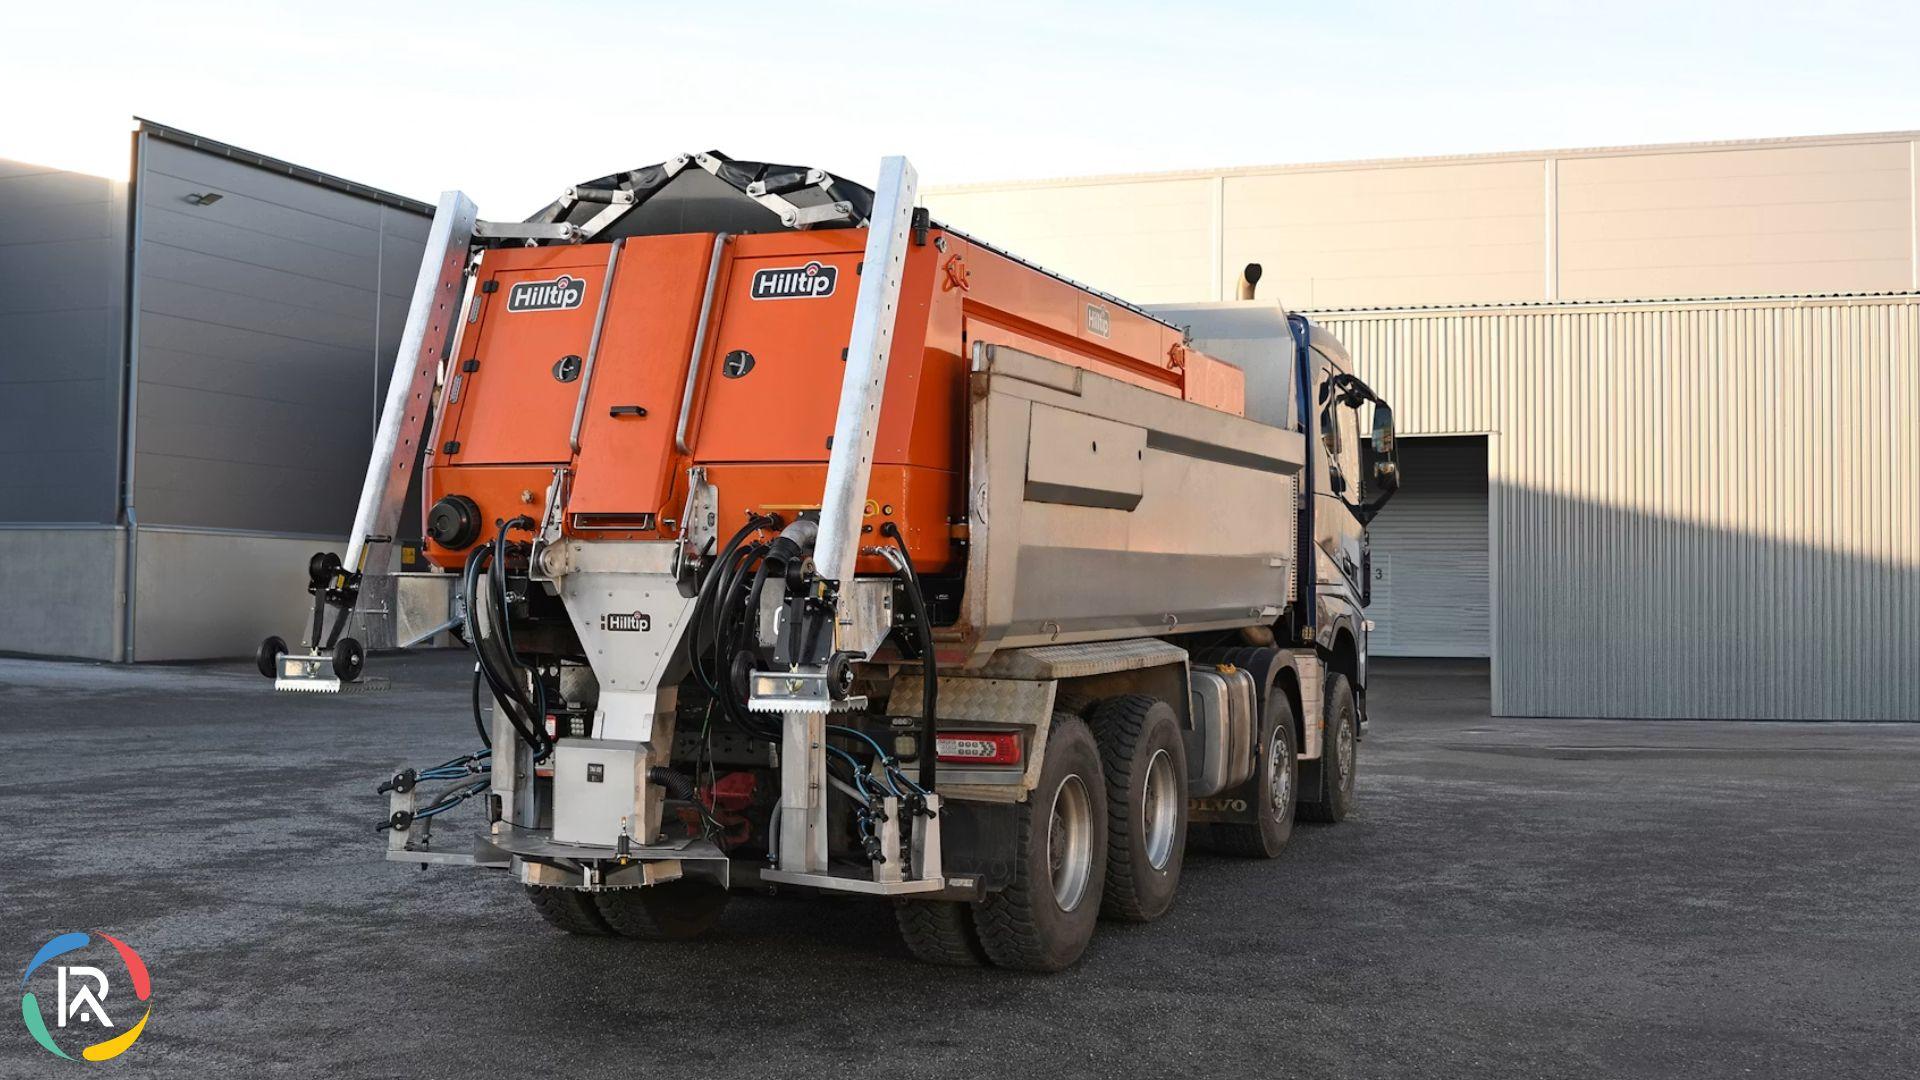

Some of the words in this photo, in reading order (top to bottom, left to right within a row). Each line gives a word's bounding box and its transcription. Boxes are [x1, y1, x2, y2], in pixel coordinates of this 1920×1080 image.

[758, 265, 830, 297] Hilltip
[514, 278, 578, 309] Hilltip
[1088, 307, 1109, 336] Hilltip
[1375, 568, 1383, 580] 3
[610, 613, 649, 631] Hilltip
[1187, 799, 1247, 812] OLVO
